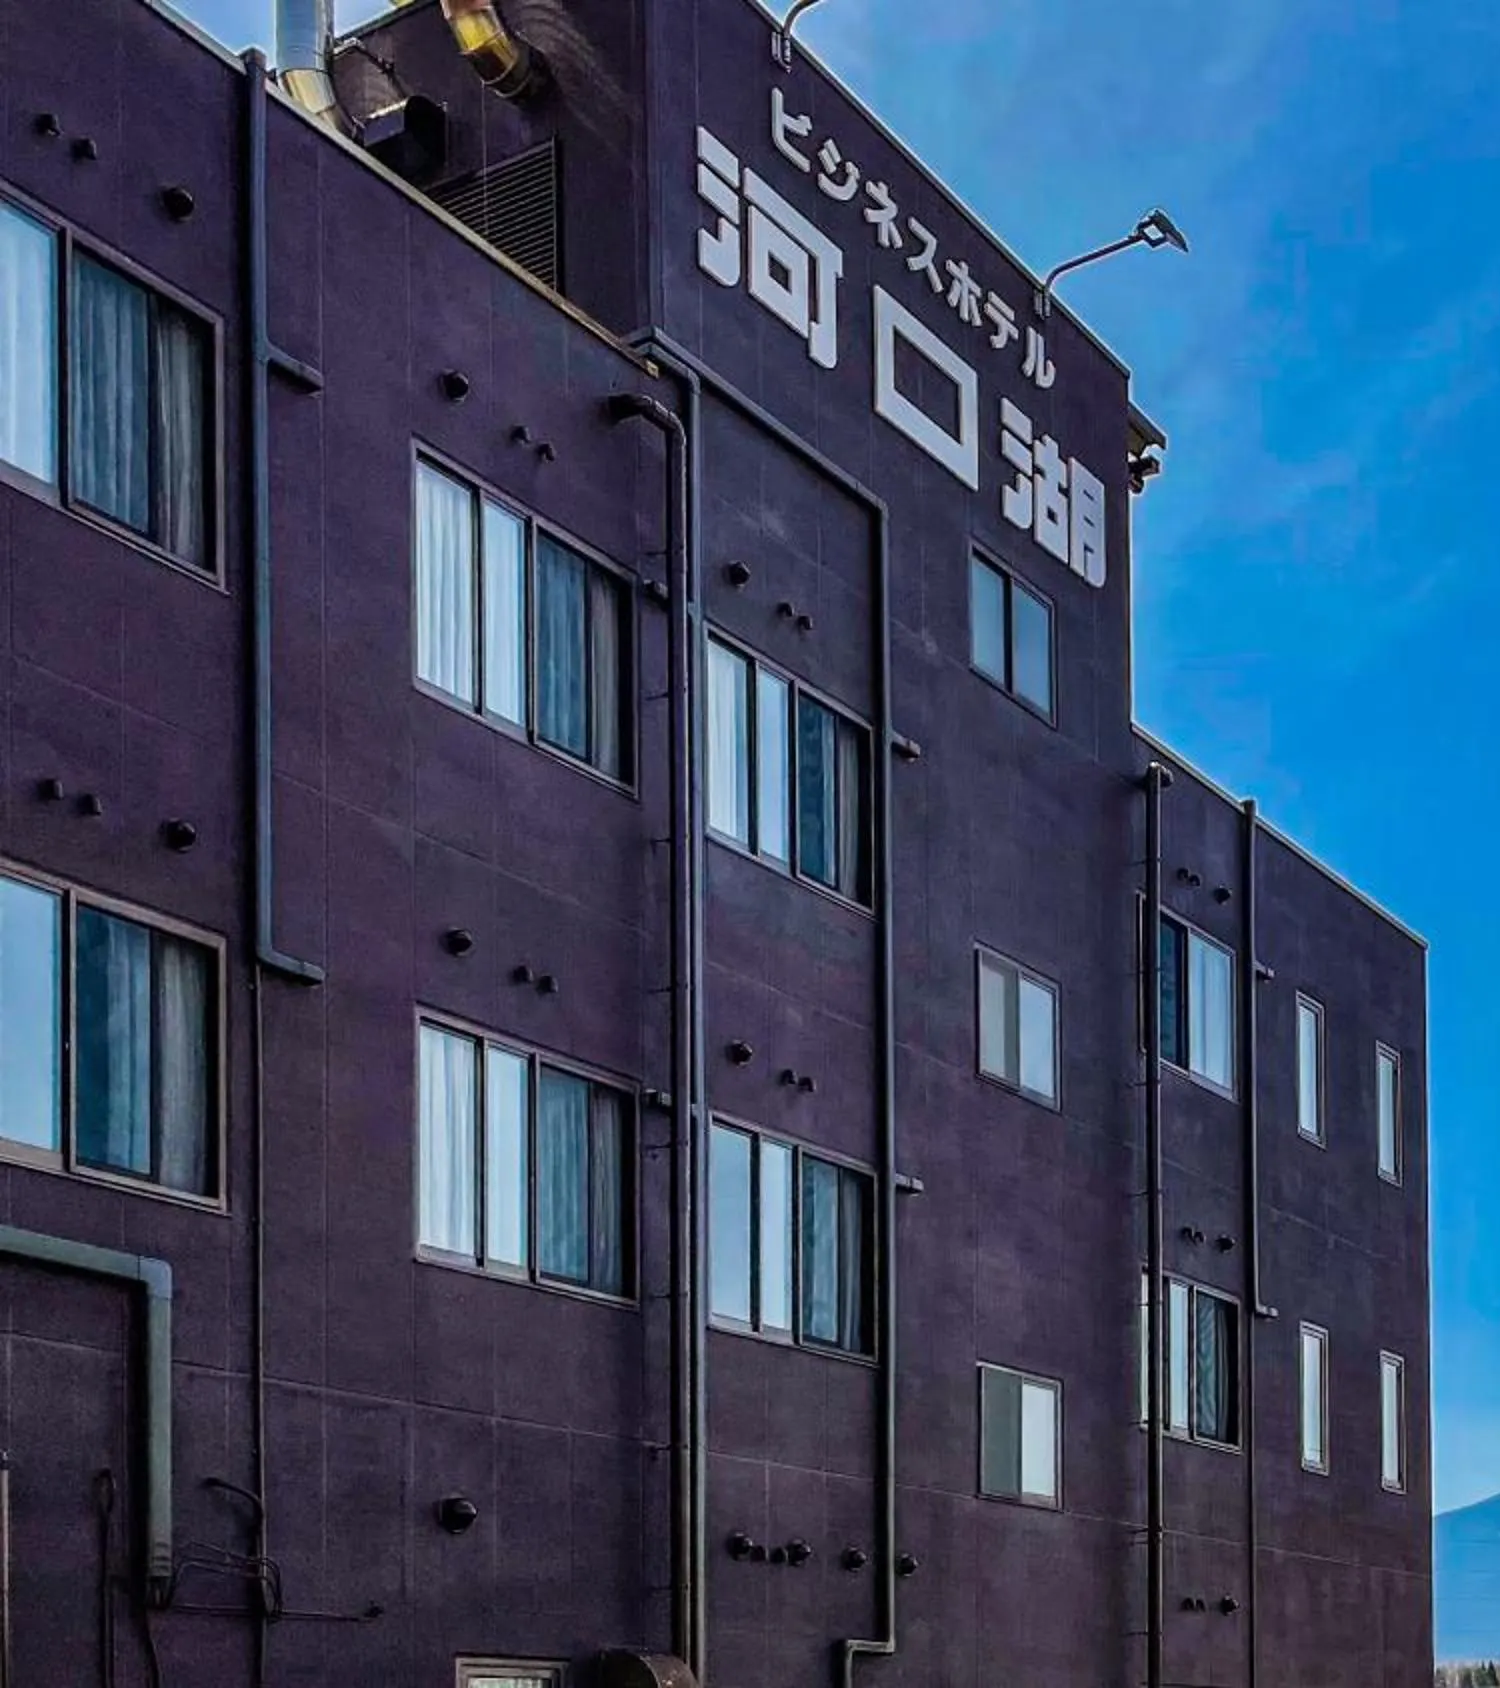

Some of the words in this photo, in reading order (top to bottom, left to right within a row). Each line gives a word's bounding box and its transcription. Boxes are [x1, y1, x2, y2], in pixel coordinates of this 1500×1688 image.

[697, 125, 1106, 588] 河口湖
[771, 87, 1056, 388] ビジネスホテル
